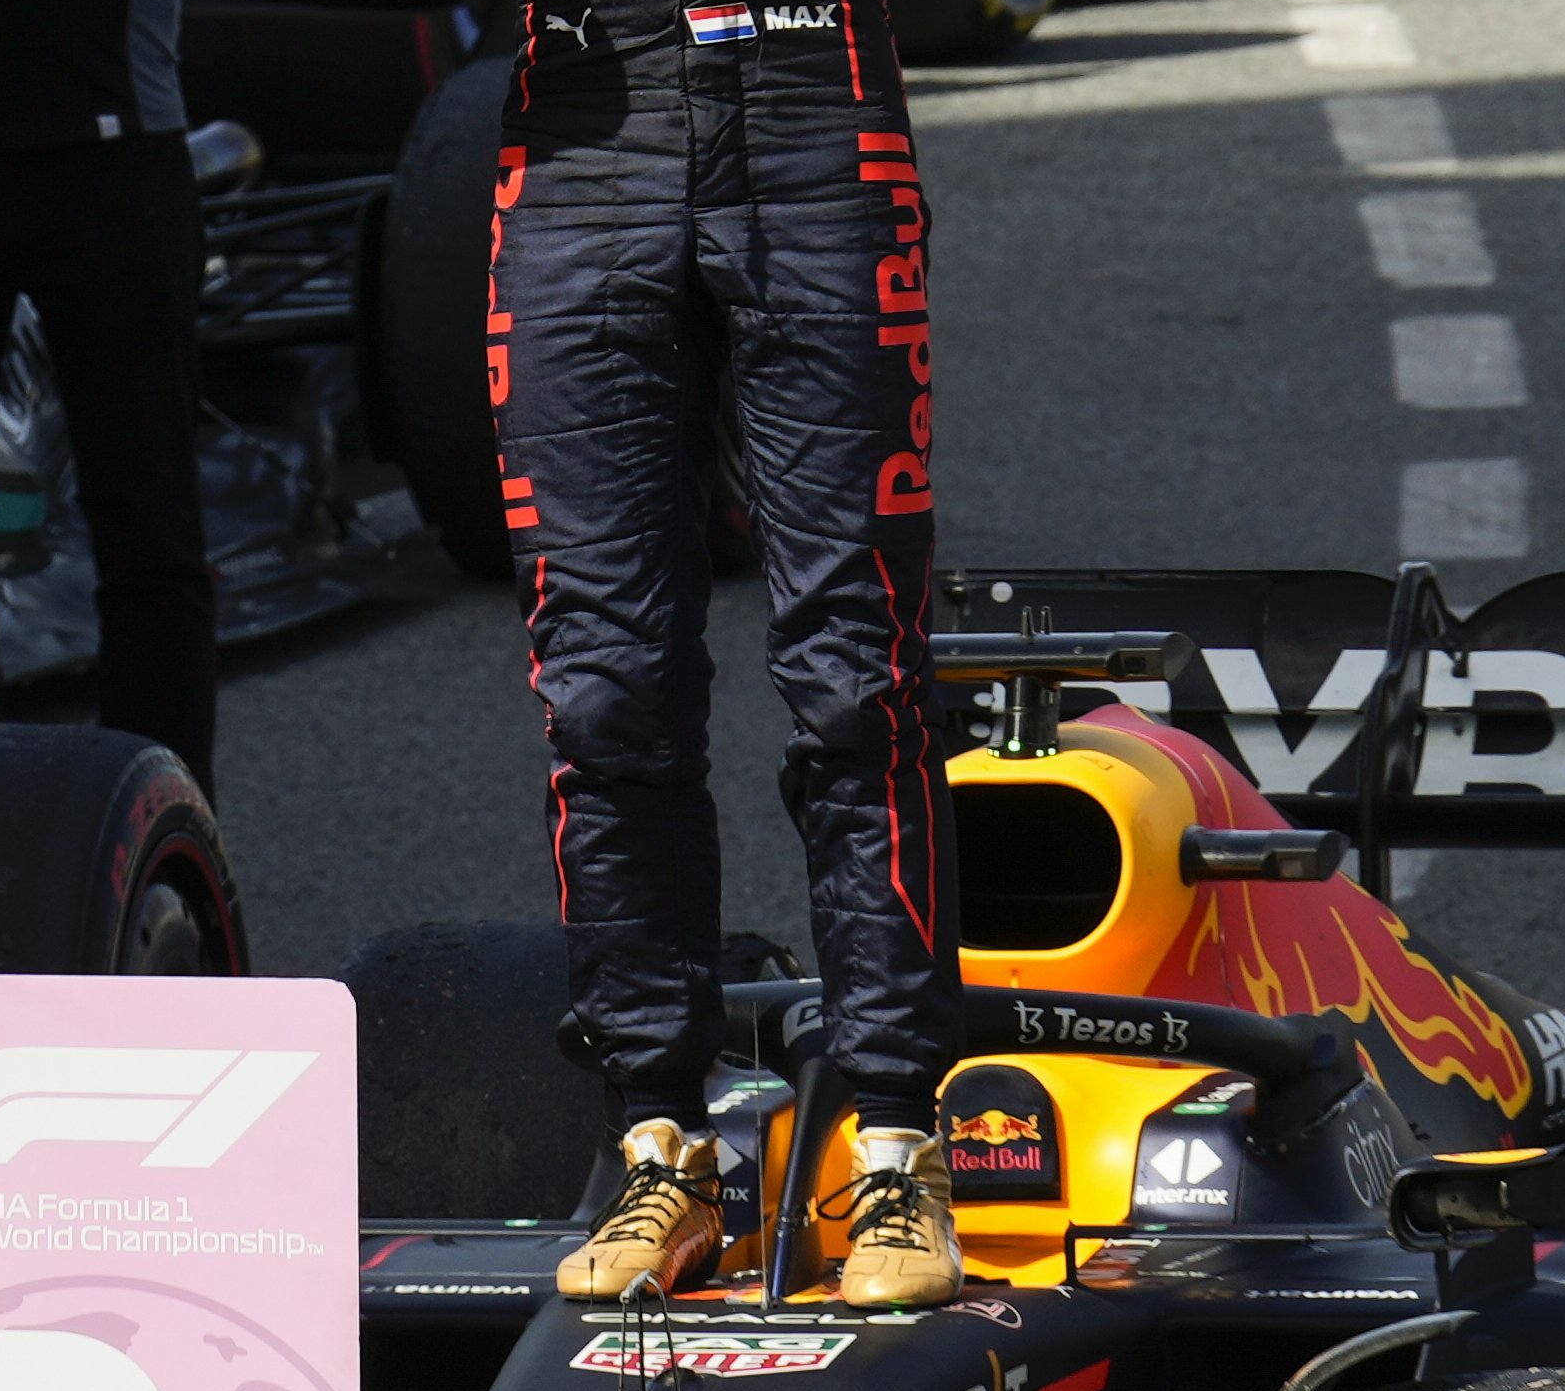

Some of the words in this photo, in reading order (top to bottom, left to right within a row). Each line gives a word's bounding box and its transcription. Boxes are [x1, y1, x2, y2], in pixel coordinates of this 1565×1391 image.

[763, 3, 837, 32] MAX
[858, 131, 932, 315] Bull
[874, 323, 934, 516] Red
[1054, 1007, 1155, 1047] Tezos
[951, 1146, 995, 1174] Red
[998, 1147, 1041, 1175] Bull
[37, 1193, 171, 1222] Formula
[176, 1196, 194, 1223] 1
[1135, 1185, 1230, 1207] inter.mx
[79, 1223, 306, 1260] Championship
[615, 1335, 840, 1351] TAG
